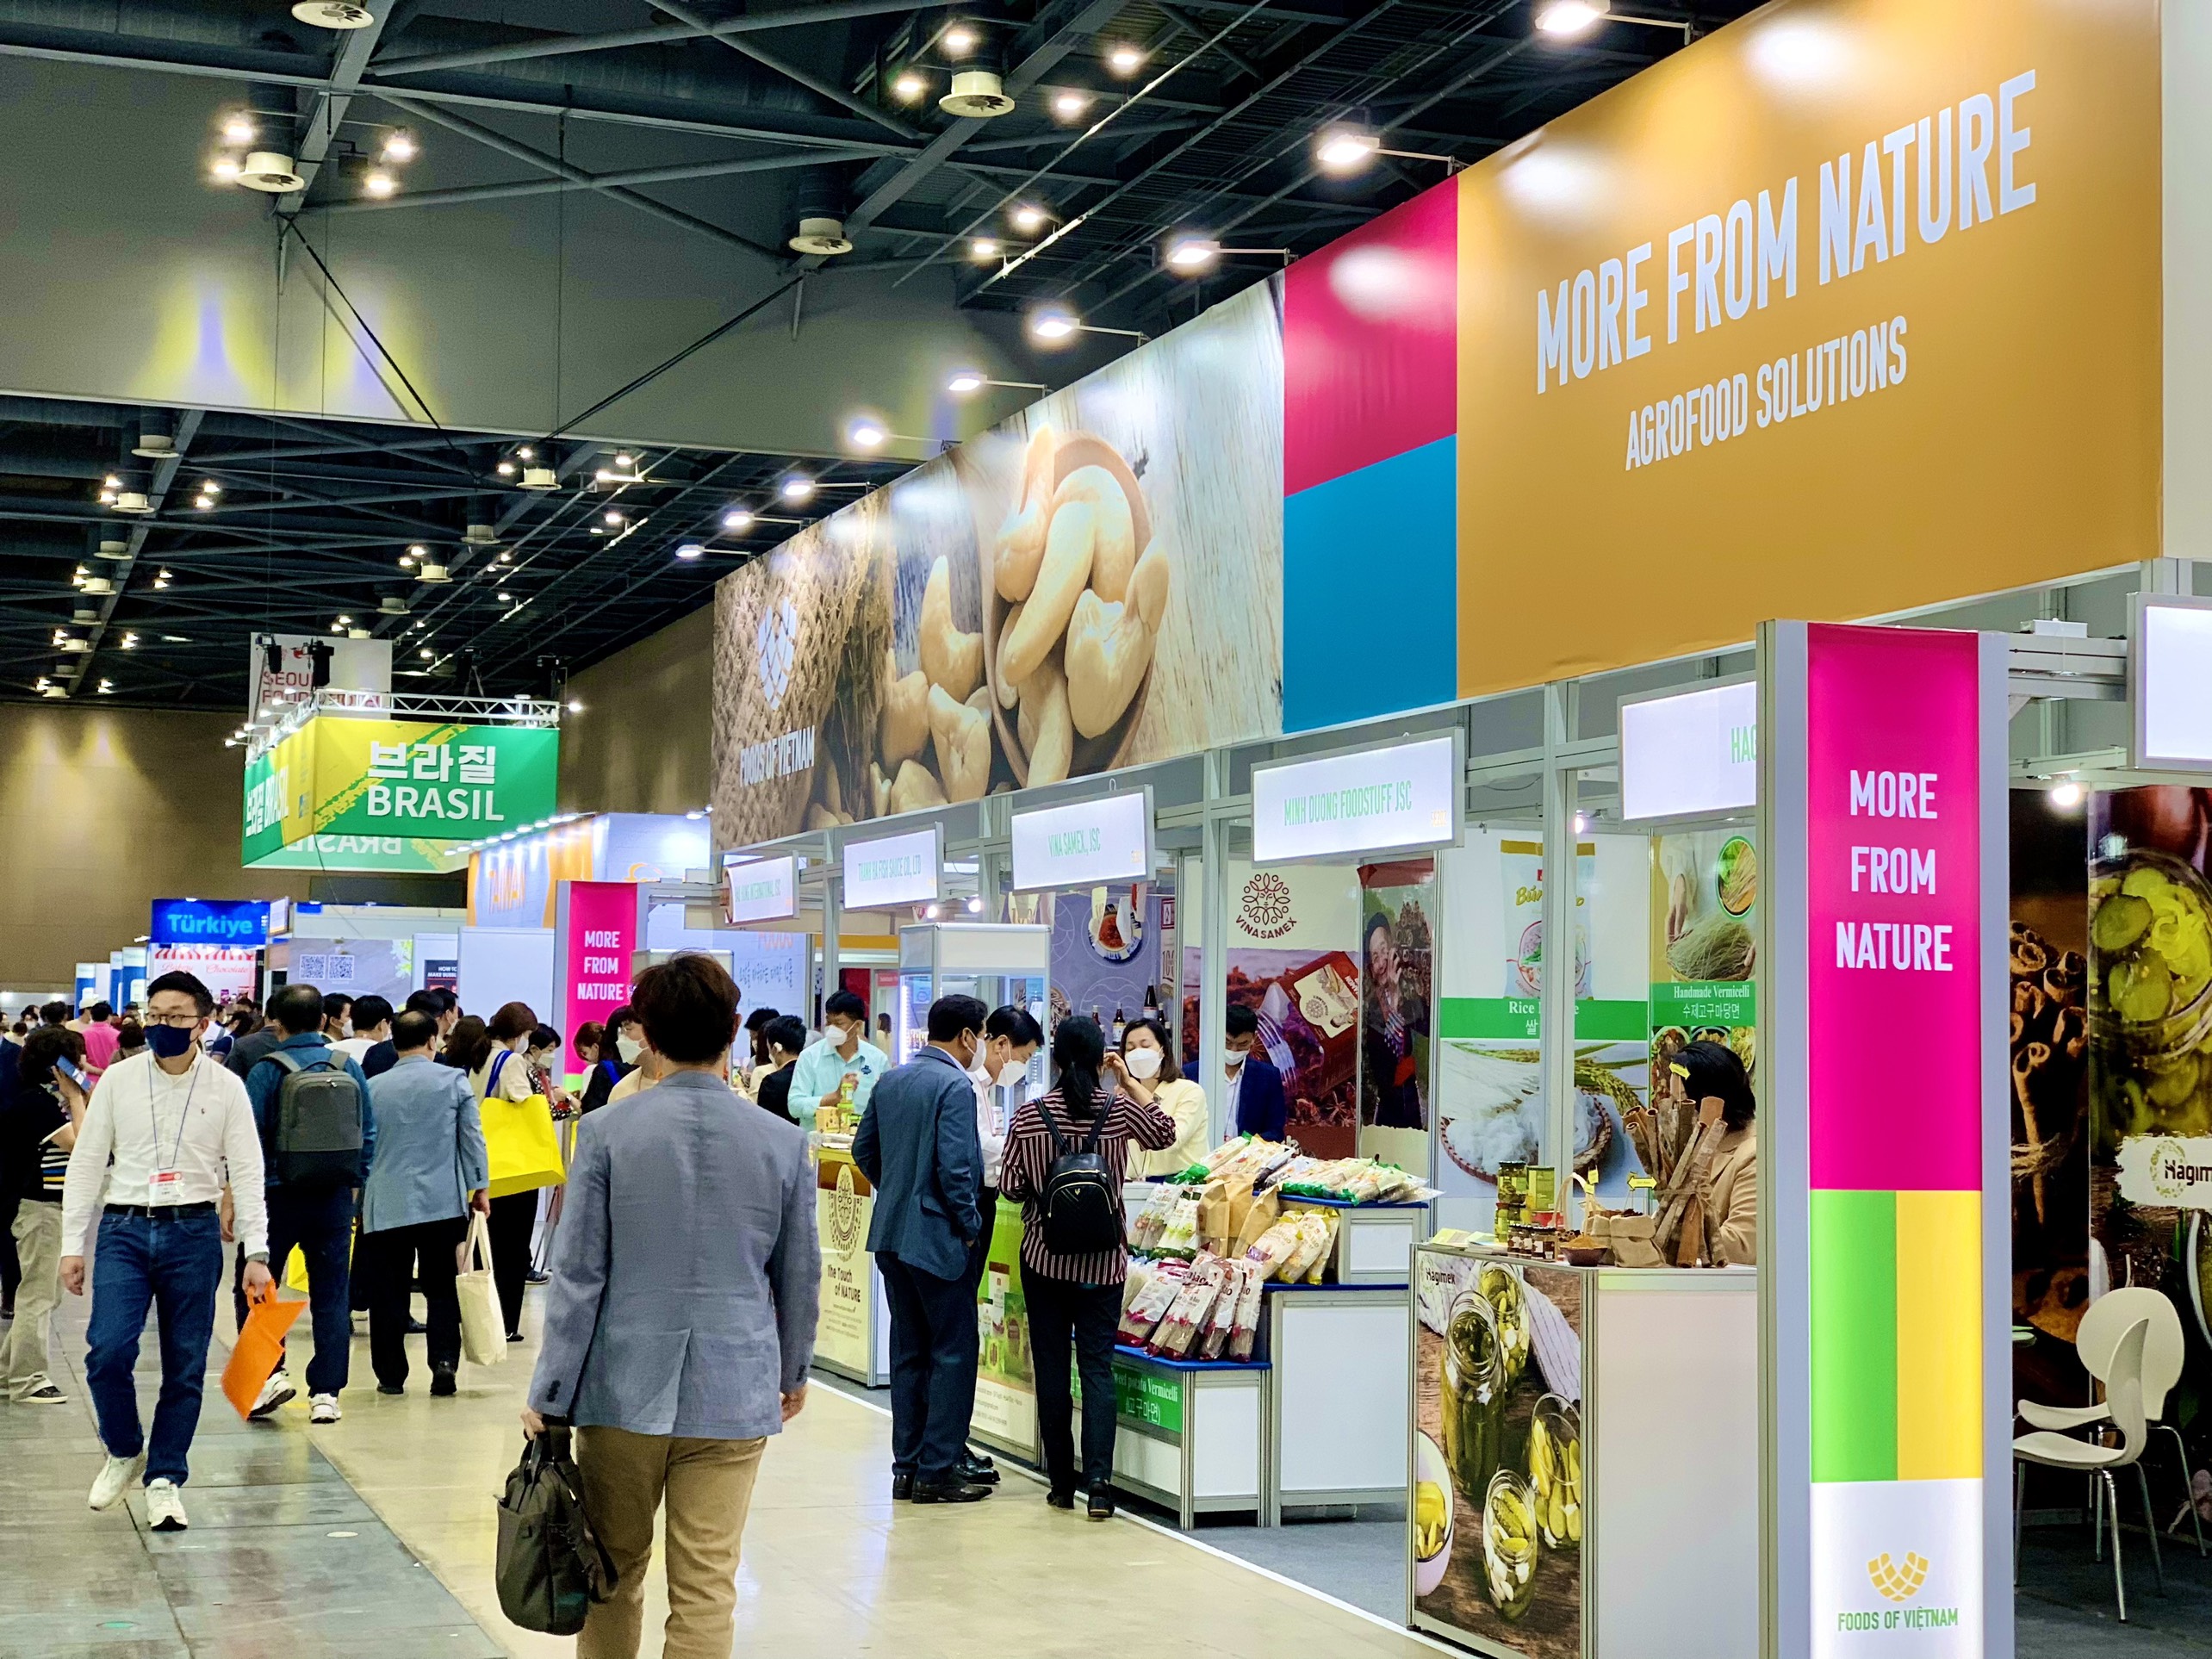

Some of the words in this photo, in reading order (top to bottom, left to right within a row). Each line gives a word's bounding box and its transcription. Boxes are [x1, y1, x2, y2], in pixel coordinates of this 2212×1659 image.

[1538, 242, 1651, 395] MORE
[1668, 176, 1798, 345] FROM
[1819, 69, 2035, 287] NATURE
[1625, 373, 1748, 471] AGROFOOD
[1756, 315, 1907, 429] SOLUTIONS
[263, 671, 313, 686] SEOU
[368, 741, 496, 785] 브라질
[740, 743, 765, 787] FOODS
[766, 738, 778, 780] OF
[367, 785, 505, 821] BRASIL
[1284, 796, 1307, 826] MINH
[1309, 791, 1338, 823] DUONG
[1340, 783, 1393, 819] FOODSTUFF
[1395, 780, 1412, 811] JSC
[1850, 769, 1938, 819] MORE
[1048, 833, 1063, 858] VINA
[1090, 827, 1101, 852] JSC
[1851, 847, 1936, 895] FROM
[167, 914, 252, 938] Türkiye
[1235, 915, 1297, 940] VINASAMEX
[584, 930, 620, 948] MORE
[1836, 921, 1954, 972] NATURE
[205, 963, 249, 974] Chocolate
[583, 956, 619, 974] FROM
[577, 983, 624, 1001] NATURE
[1674, 985, 1712, 998] Handmade
[1712, 985, 1749, 998] Vermicelli
[1509, 1001, 1535, 1014] Rice
[1682, 1003, 1740, 1020] 수제고구마당면
[828, 1264, 836, 1279] The
[837, 1267, 853, 1283] Touch
[1426, 1267, 1456, 1285] Hagimex
[841, 1285, 861, 1302] NATURE
[1147, 1378, 1177, 1402] Vermicelli
[1838, 1612, 1880, 1631] FOODS
[1884, 1611, 1900, 1629] OF
